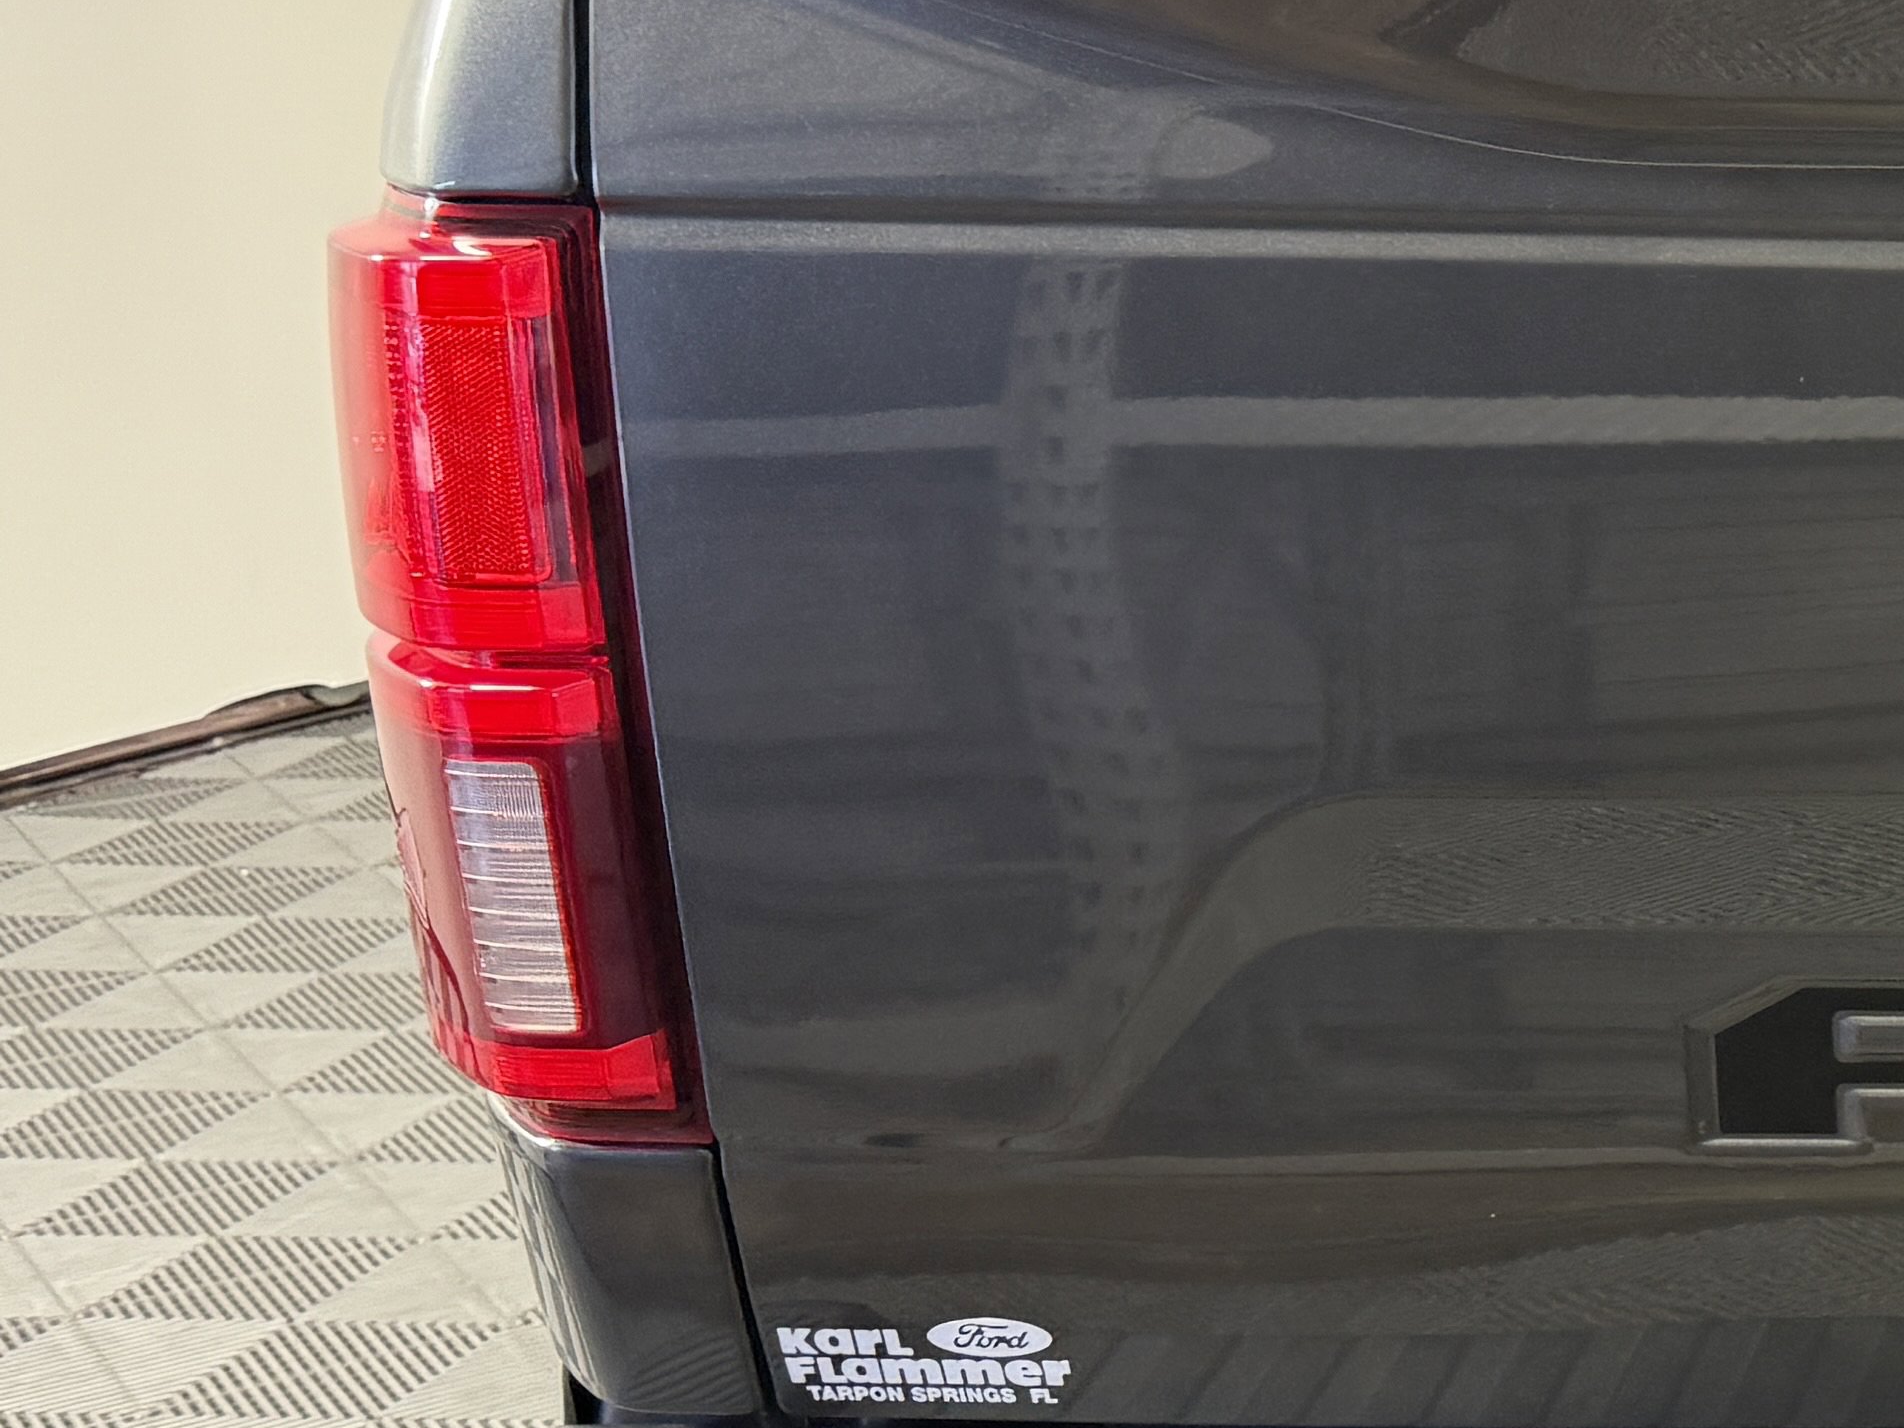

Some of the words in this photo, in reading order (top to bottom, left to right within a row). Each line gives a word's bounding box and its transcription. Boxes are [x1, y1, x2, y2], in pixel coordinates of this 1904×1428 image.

[953, 1322, 1030, 1349] Ford
[806, 1384, 905, 1403] TARPON
[911, 1386, 1017, 1404] SPRINGS
[1030, 1388, 1059, 1404] FL
